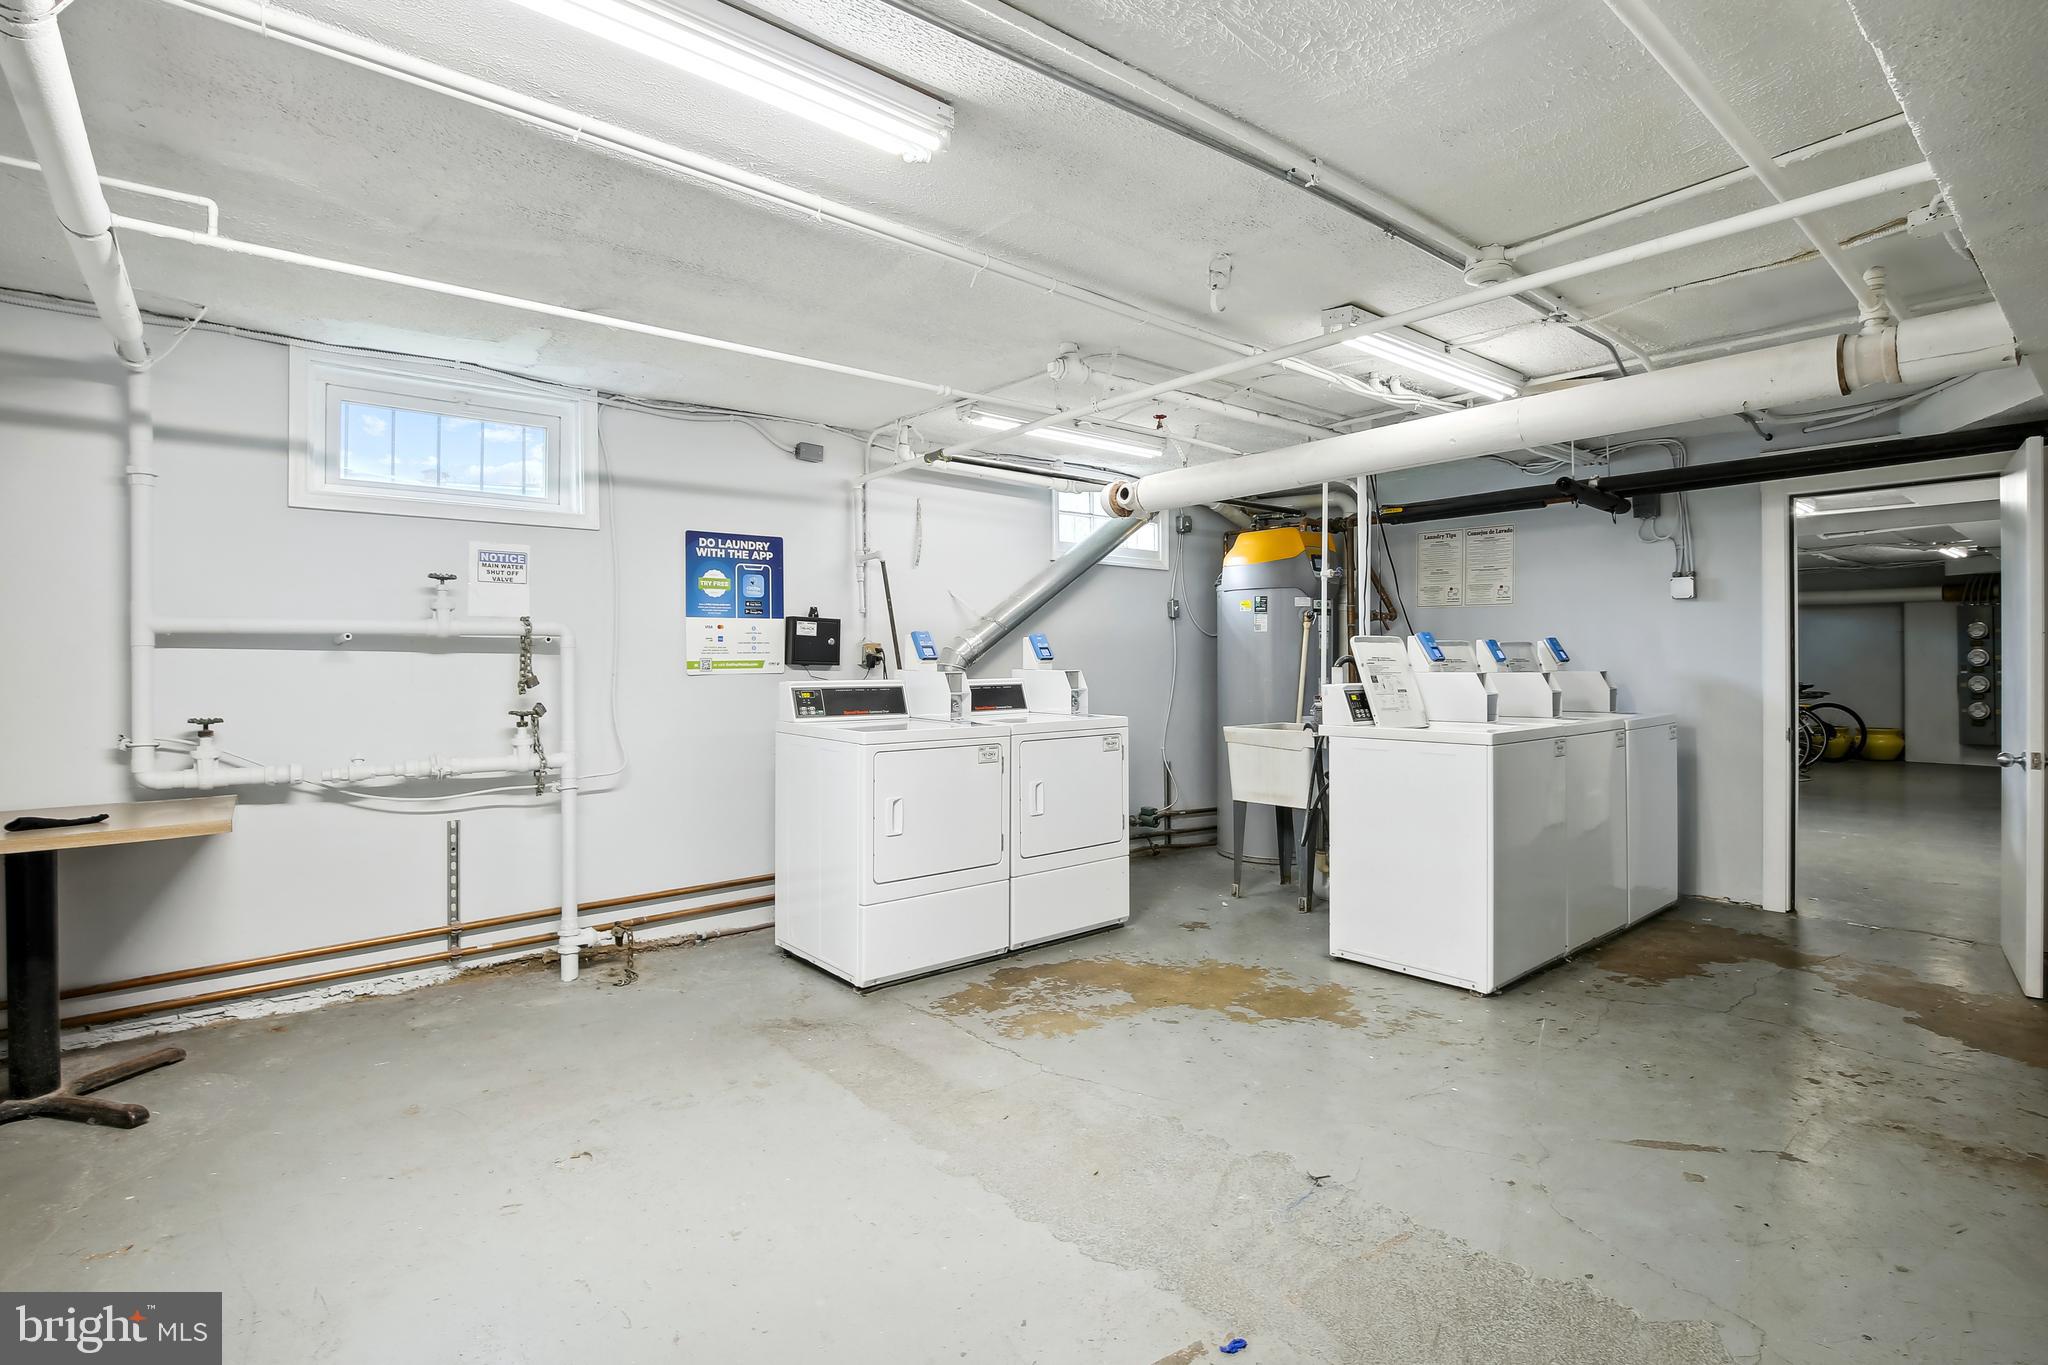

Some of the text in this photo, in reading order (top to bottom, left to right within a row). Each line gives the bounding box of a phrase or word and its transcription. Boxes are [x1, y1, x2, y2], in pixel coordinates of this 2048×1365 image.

[698, 537, 770, 550] DO LAUNDRY
[480, 553, 525, 563] NOTICE
[696, 547, 774, 560] WITH THE APP
